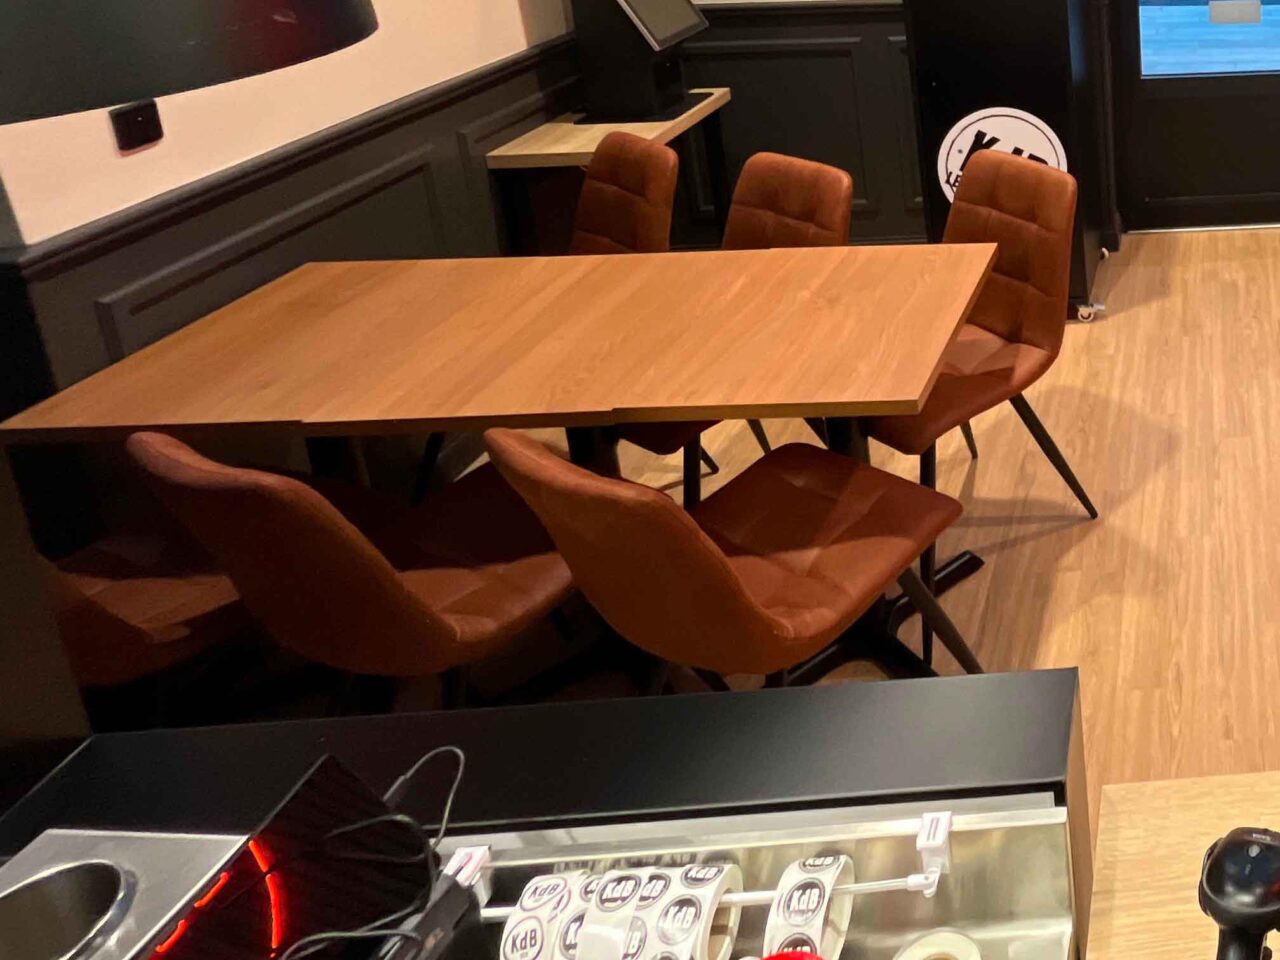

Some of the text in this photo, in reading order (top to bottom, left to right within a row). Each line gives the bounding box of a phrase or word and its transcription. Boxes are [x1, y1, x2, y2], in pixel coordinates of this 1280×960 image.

[528, 883, 560, 900] KdB
[601, 879, 636, 900] KdB
[789, 888, 820, 911] KdB
[662, 905, 696, 929] KdB
[511, 929, 537, 954] KdB
